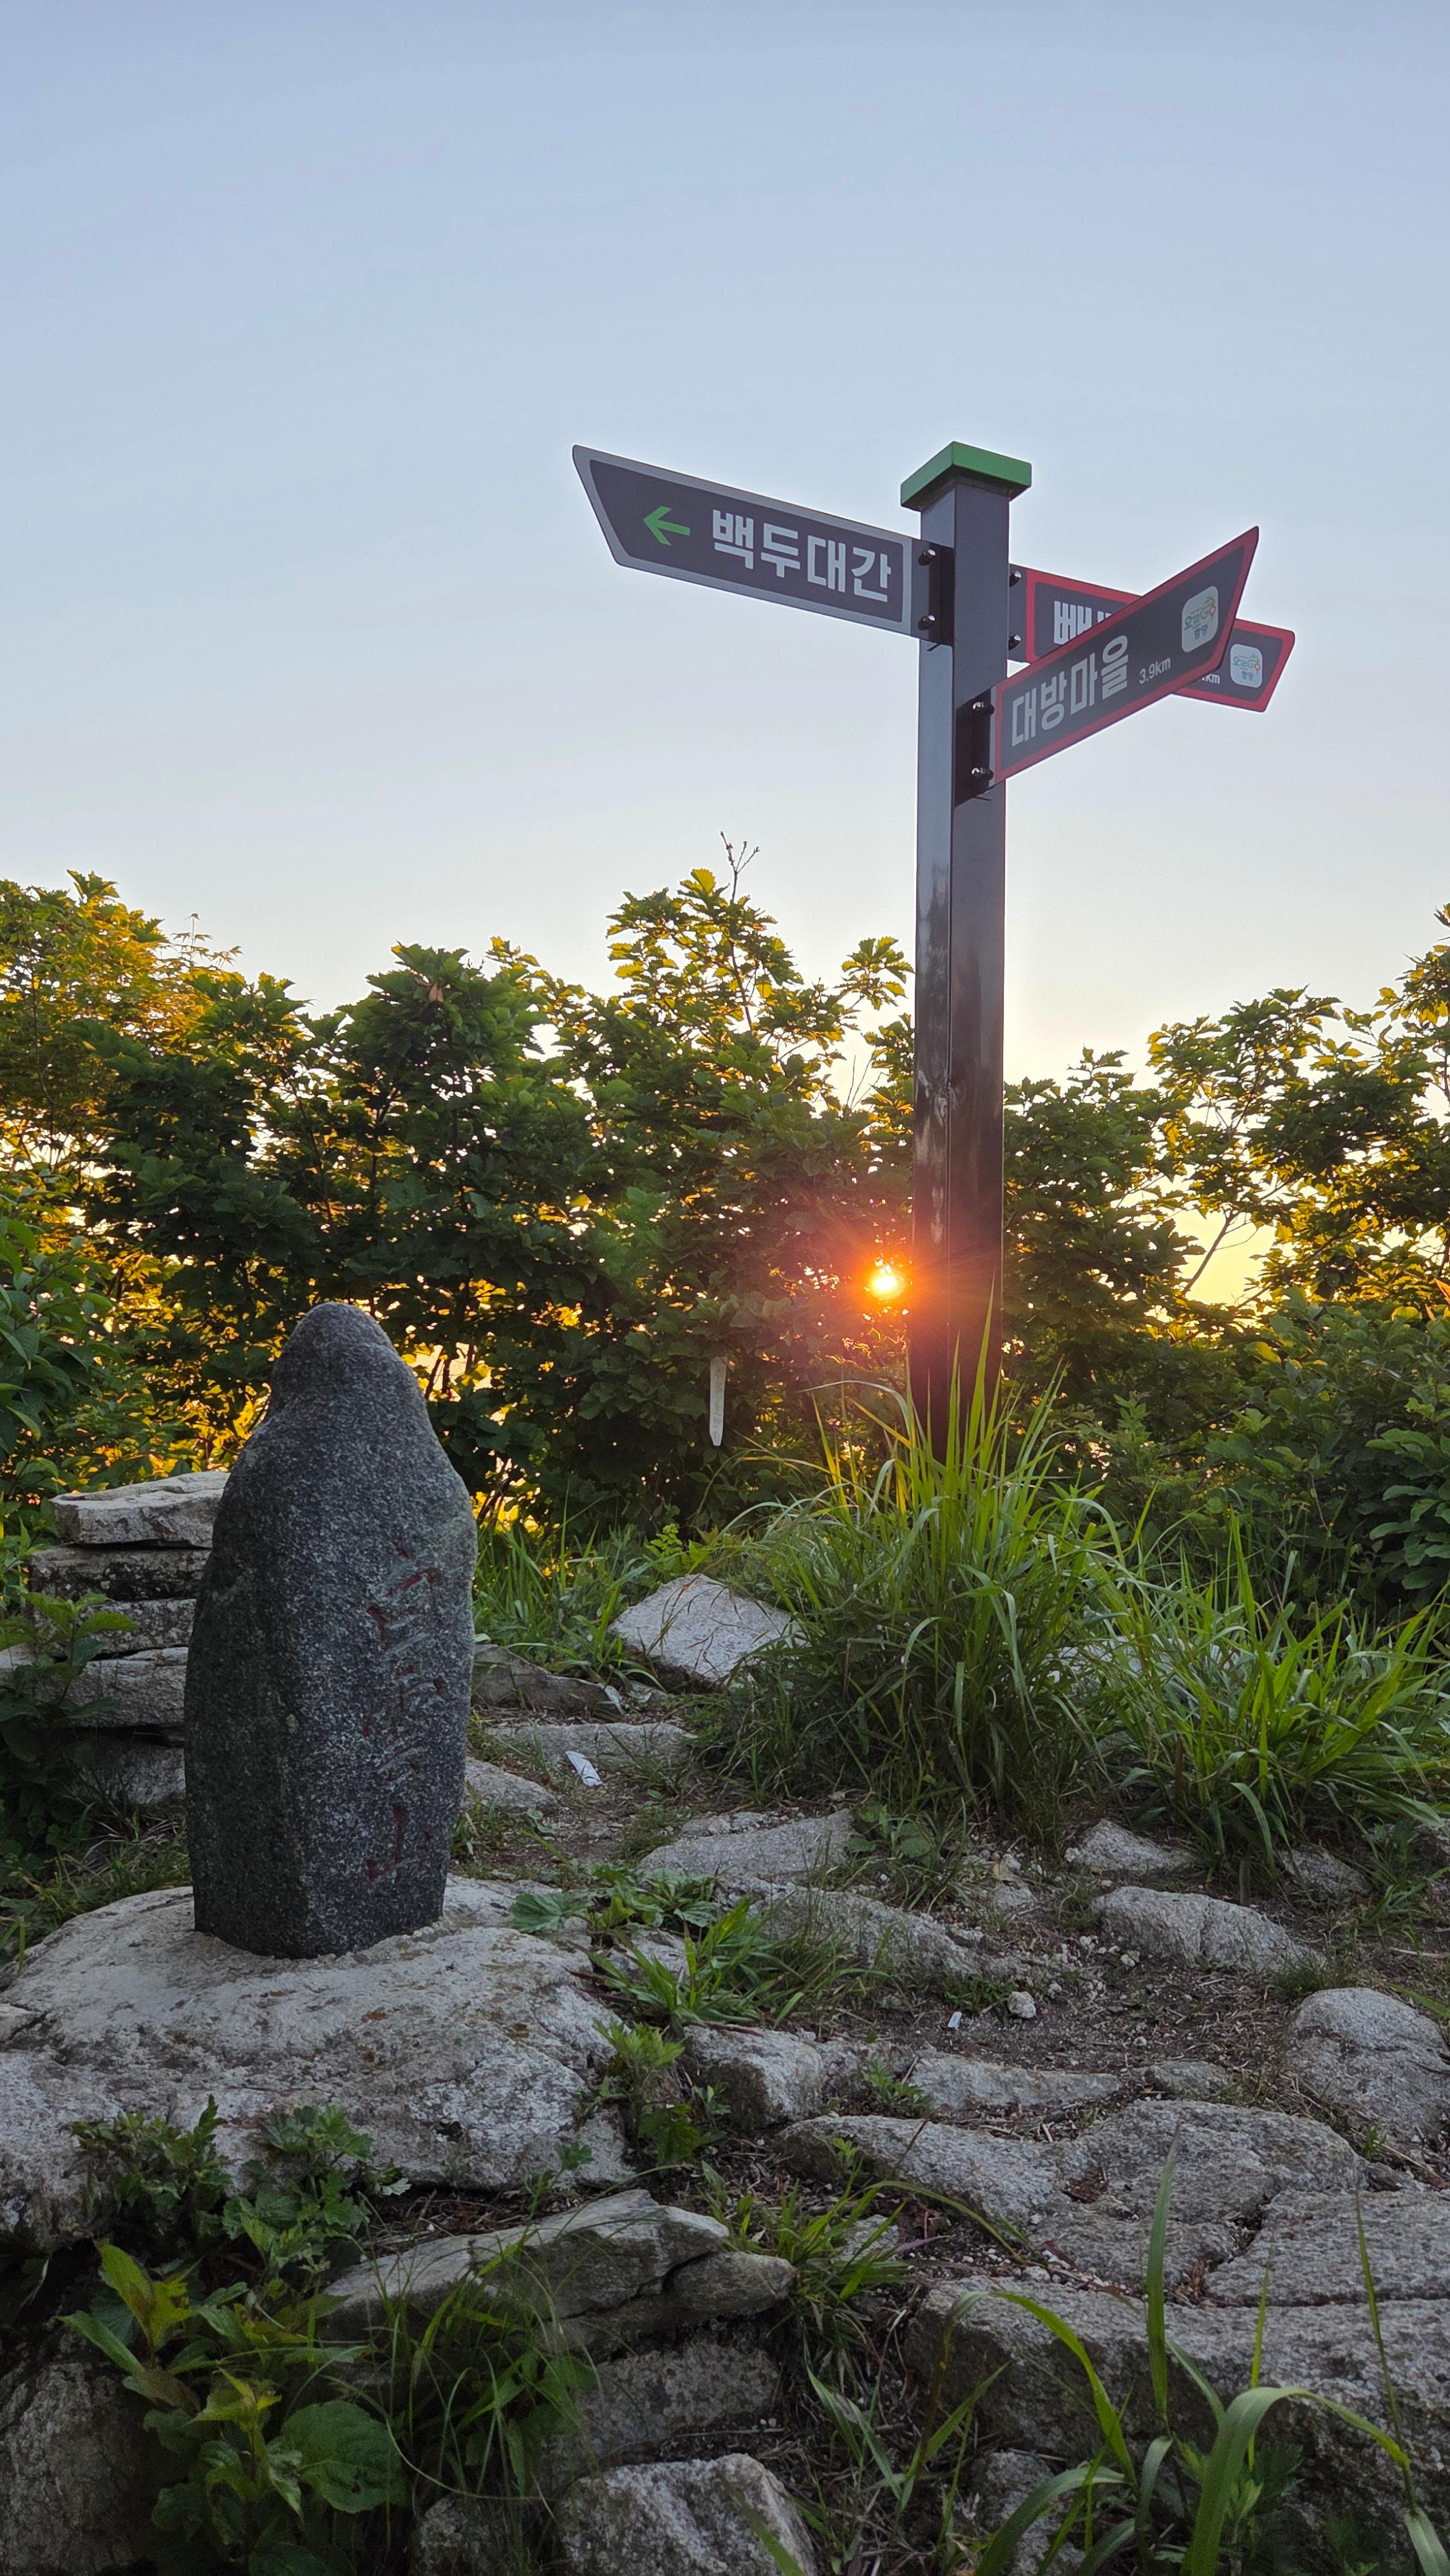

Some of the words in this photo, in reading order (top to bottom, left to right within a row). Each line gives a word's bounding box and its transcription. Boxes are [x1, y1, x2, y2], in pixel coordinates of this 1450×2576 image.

[713, 509, 892, 603] 백두대간
[1011, 635, 1129, 747] 대방마을
[1139, 658, 1171, 684] 3.9km
